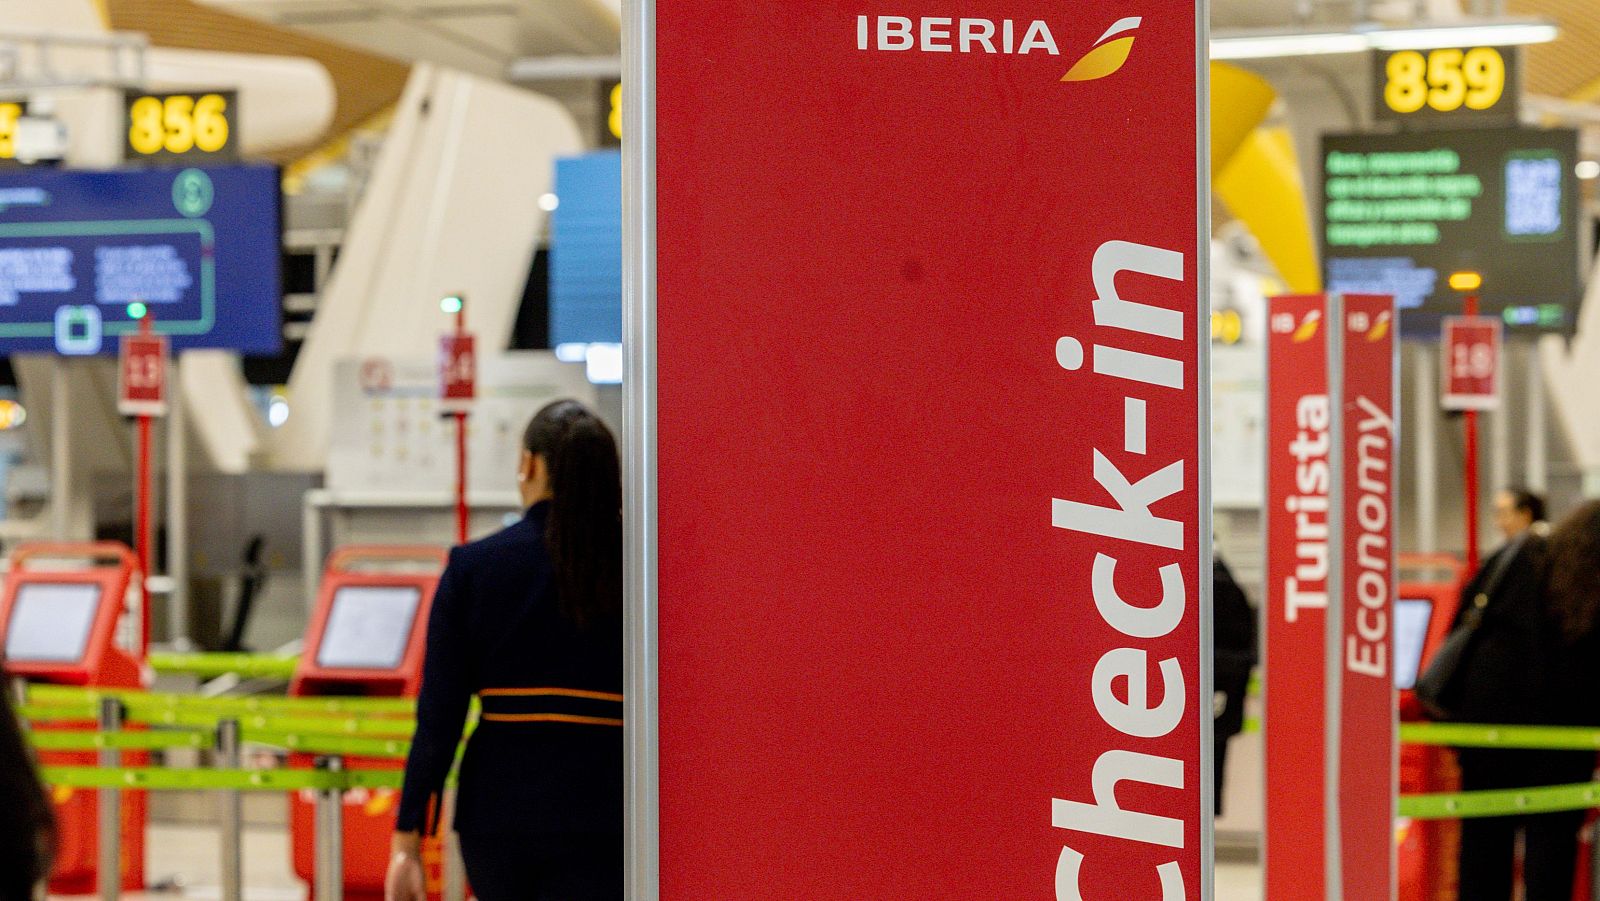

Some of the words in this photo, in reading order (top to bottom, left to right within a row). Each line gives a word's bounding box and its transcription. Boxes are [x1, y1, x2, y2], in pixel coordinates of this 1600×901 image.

[857, 15, 1060, 55] IBERIA
[1384, 46, 1505, 113] 859
[129, 94, 229, 154] 856
[1285, 394, 1329, 623] Turista
[1347, 396, 1394, 678] Economy
